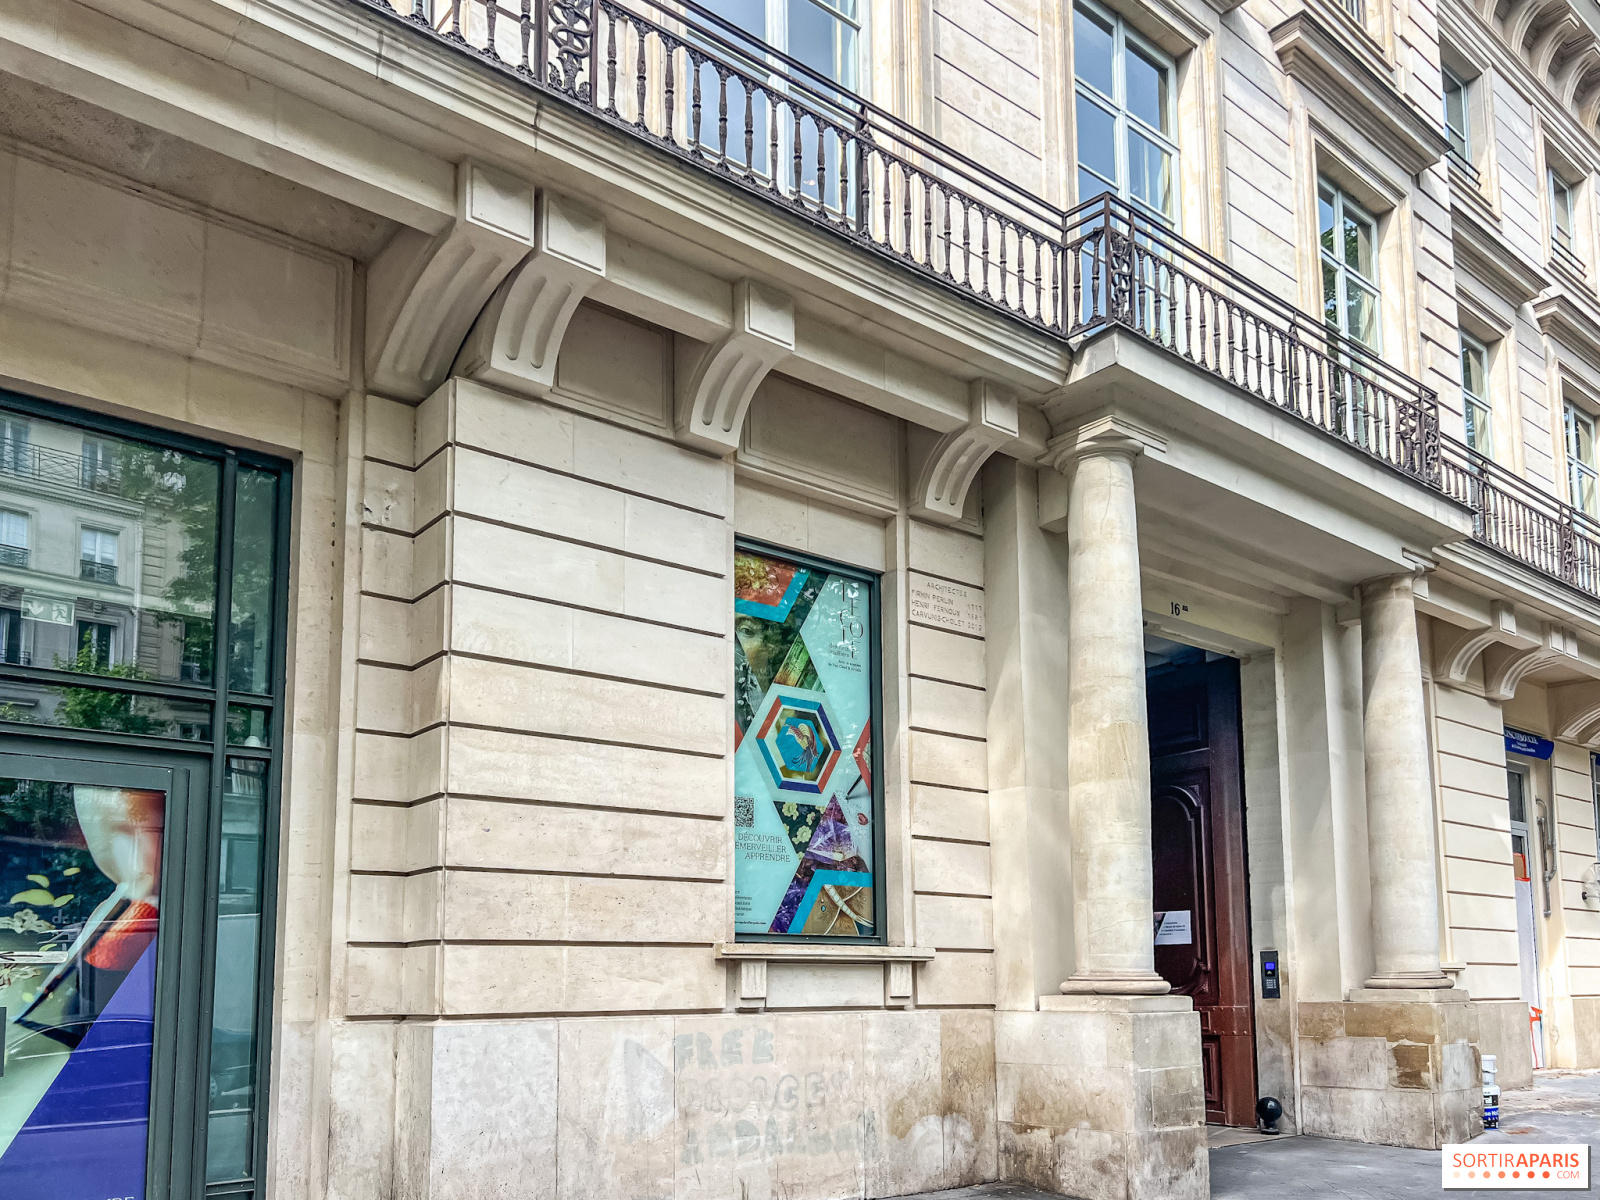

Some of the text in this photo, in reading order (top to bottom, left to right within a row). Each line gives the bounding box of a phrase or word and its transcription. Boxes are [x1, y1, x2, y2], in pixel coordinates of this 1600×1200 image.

[927, 582, 967, 598] ARCHITECTES
[911, 599, 930, 609] HENRI
[933, 604, 961, 617] FERNOUX
[1171, 601, 1181, 616] 16
[967, 621, 983, 632] 2012
[738, 831, 783, 844] DÉCOUVRIR
[744, 852, 791, 863] APPRENDRE
[672, 1029, 775, 1070] FREE
